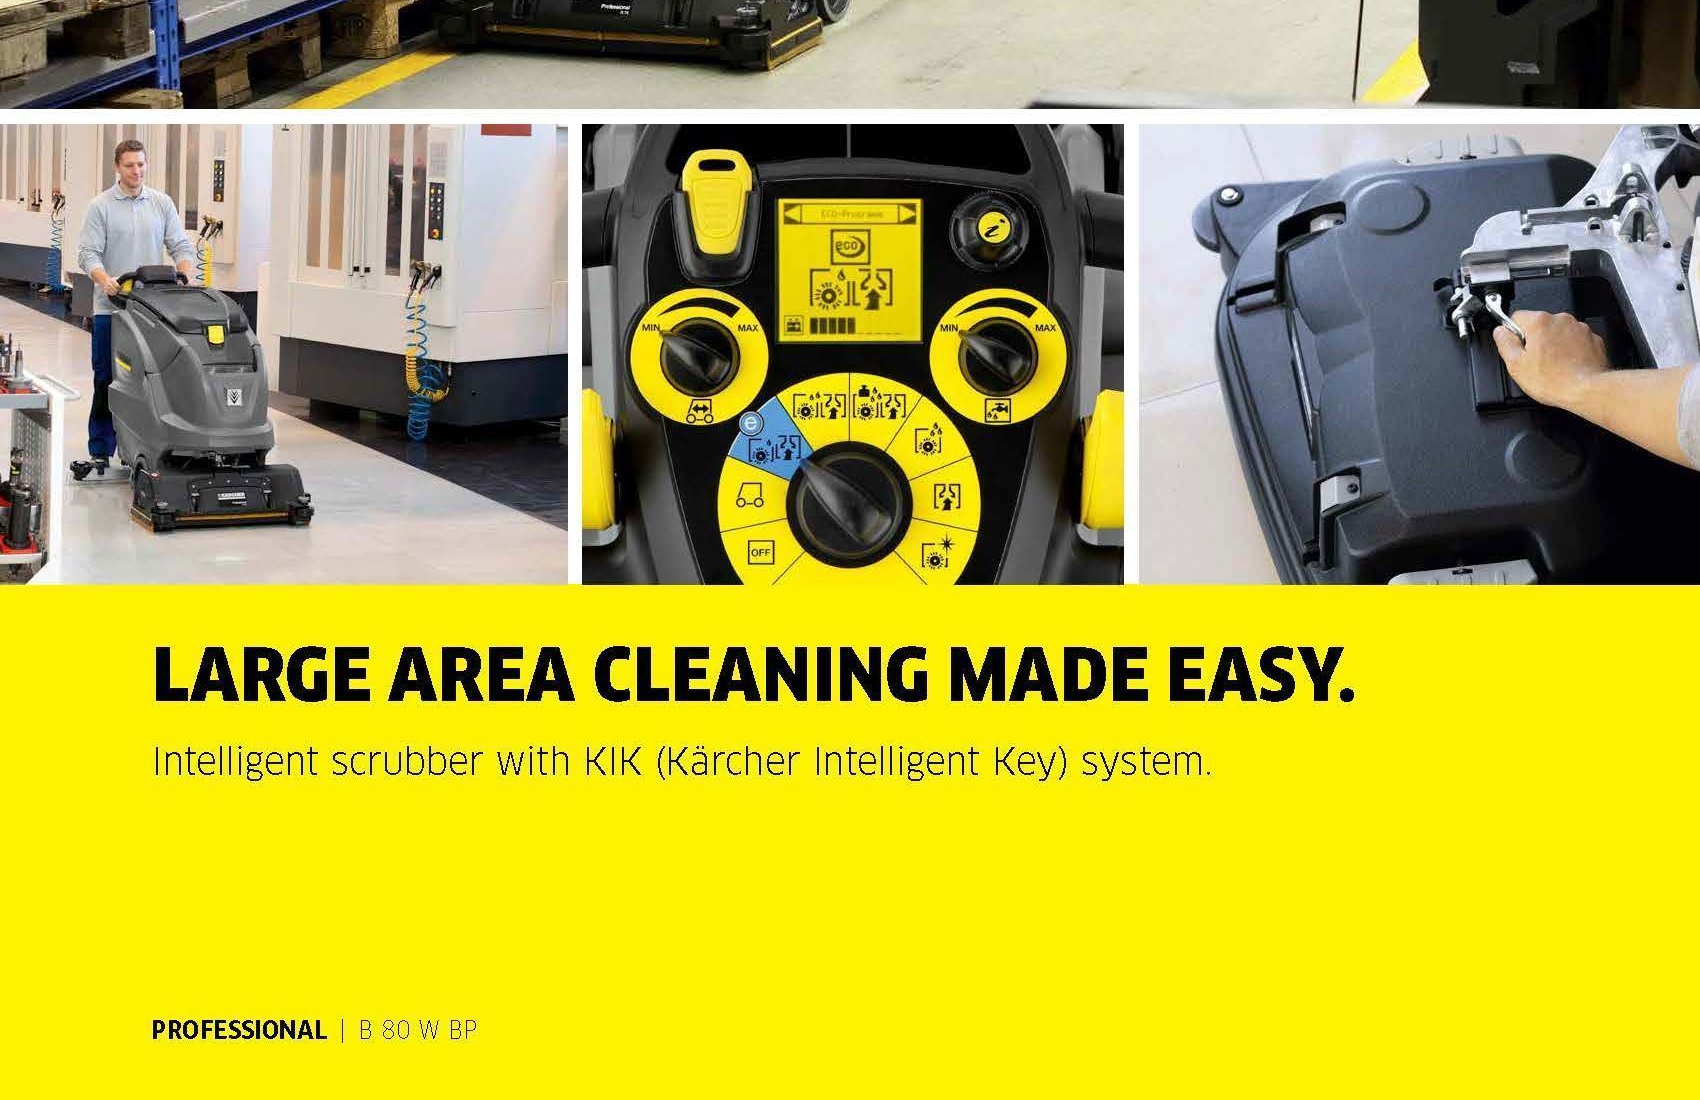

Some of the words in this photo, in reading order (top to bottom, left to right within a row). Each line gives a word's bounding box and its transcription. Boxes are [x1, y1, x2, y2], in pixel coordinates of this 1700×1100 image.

[641, 323, 661, 332] MIN
[737, 323, 759, 332] MAX
[940, 323, 959, 332] MIN
[1035, 323, 1057, 332] MAX
[751, 548, 771, 557] OFF
